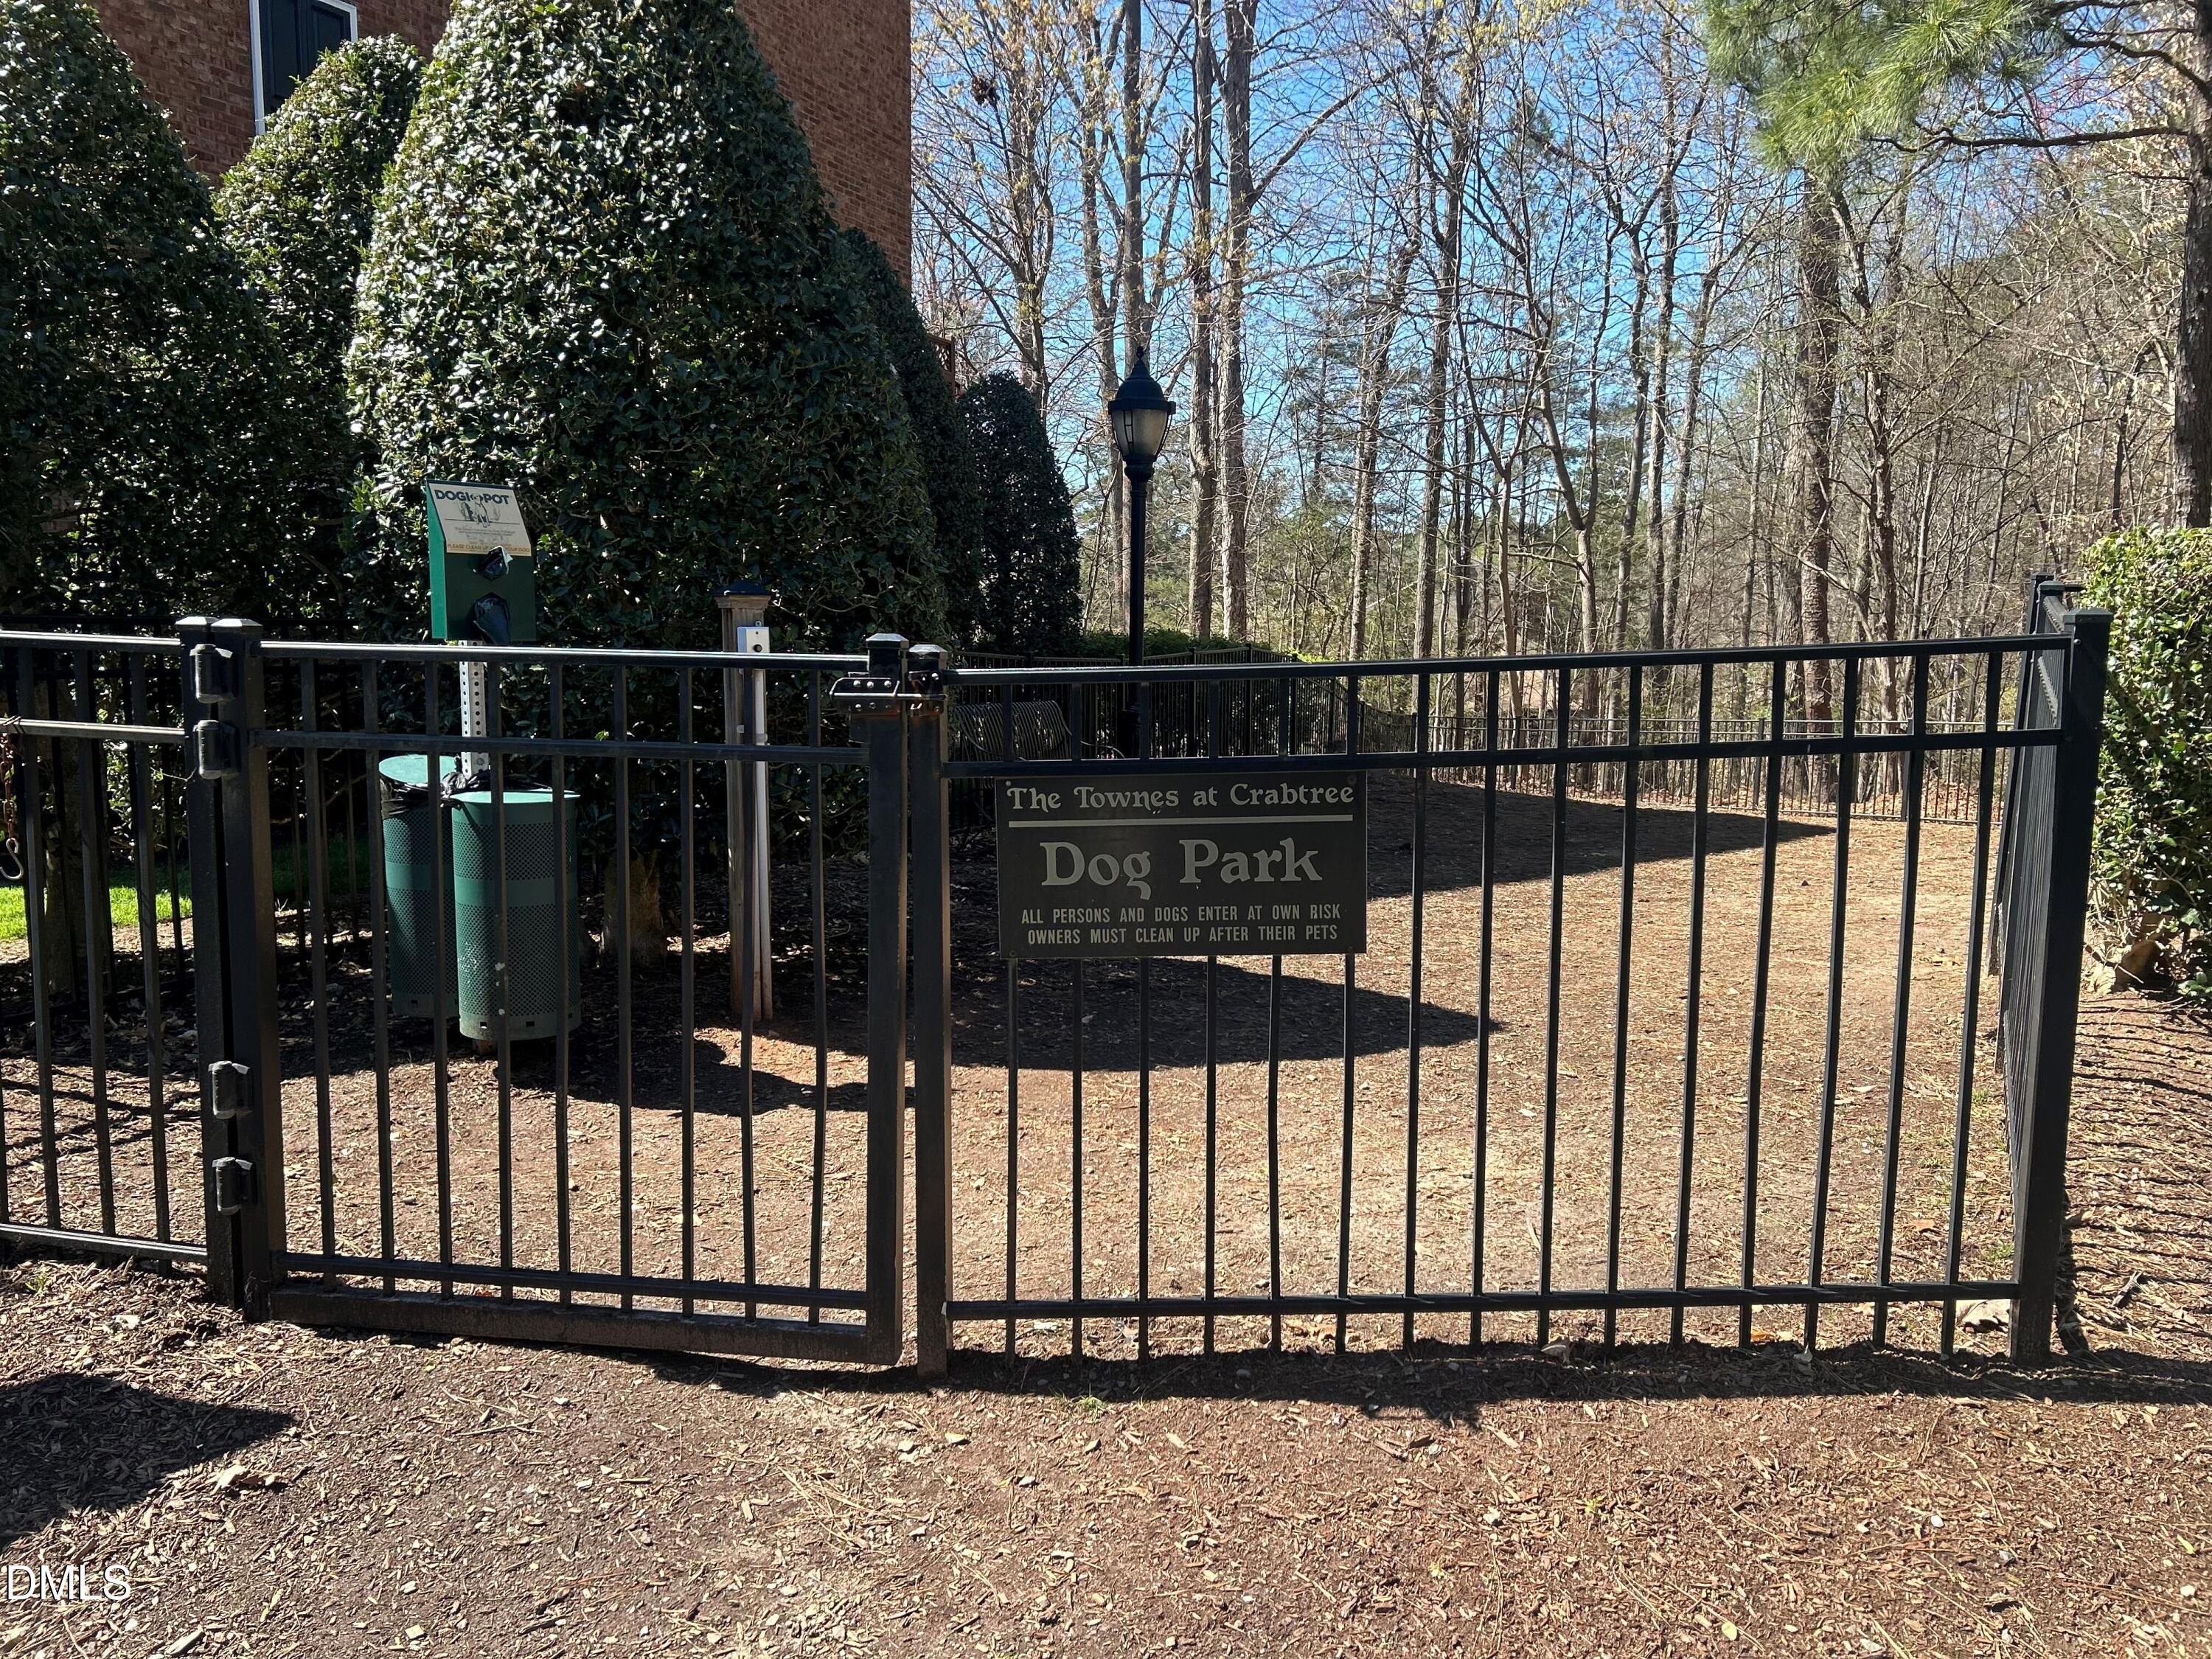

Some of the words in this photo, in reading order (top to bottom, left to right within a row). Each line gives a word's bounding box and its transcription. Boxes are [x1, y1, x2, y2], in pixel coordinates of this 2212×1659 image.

[1006, 787, 1061, 813] The
[1074, 786, 1180, 810] Townes
[1193, 787, 1217, 806] at
[1230, 782, 1354, 805] Crabtree
[1040, 841, 1152, 900] Dog
[1179, 838, 1323, 883] Park
[1021, 909, 1044, 924] ALL
[1053, 908, 1110, 923] PERSONS
[1119, 908, 1144, 922] AND
[1155, 906, 1189, 922] DOGS
[1198, 906, 1237, 921] ENTER
[1248, 905, 1263, 920] AT
[1272, 905, 1300, 919] OWN
[1310, 904, 1340, 919] RISK
[1028, 929, 1080, 945] OWNERS
[1091, 928, 1127, 944] MUST
[1135, 928, 1174, 943] CLEAN
[1183, 927, 1200, 942] UP
[1209, 926, 1248, 942] AFTER
[1258, 925, 1295, 941] THEIR
[1306, 925, 1338, 940] PETS
